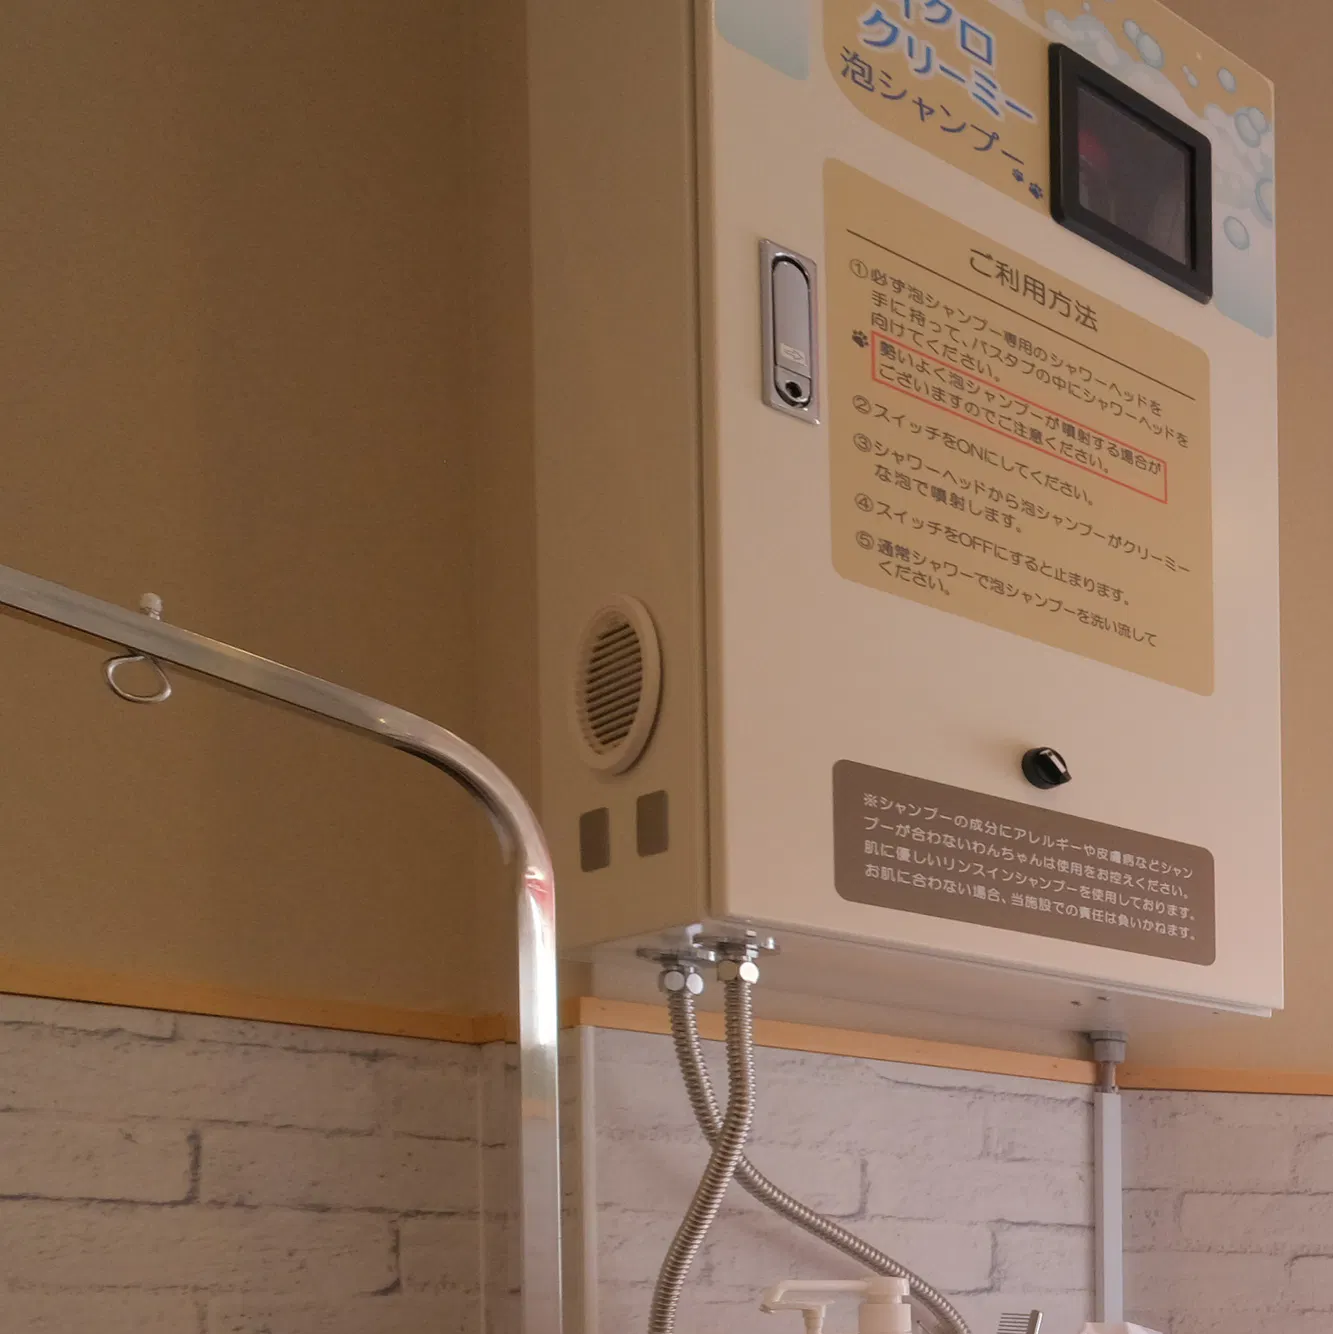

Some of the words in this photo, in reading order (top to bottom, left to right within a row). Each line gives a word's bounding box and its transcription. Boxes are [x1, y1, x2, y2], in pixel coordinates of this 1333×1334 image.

[840, 46, 1025, 165] 泡シャンプー
[863, 9, 1033, 119] クリーミー
[968, 247, 1098, 332] ご利用方法
[871, 311, 1001, 382] 向けてください。
[878, 560, 951, 596] ください。
